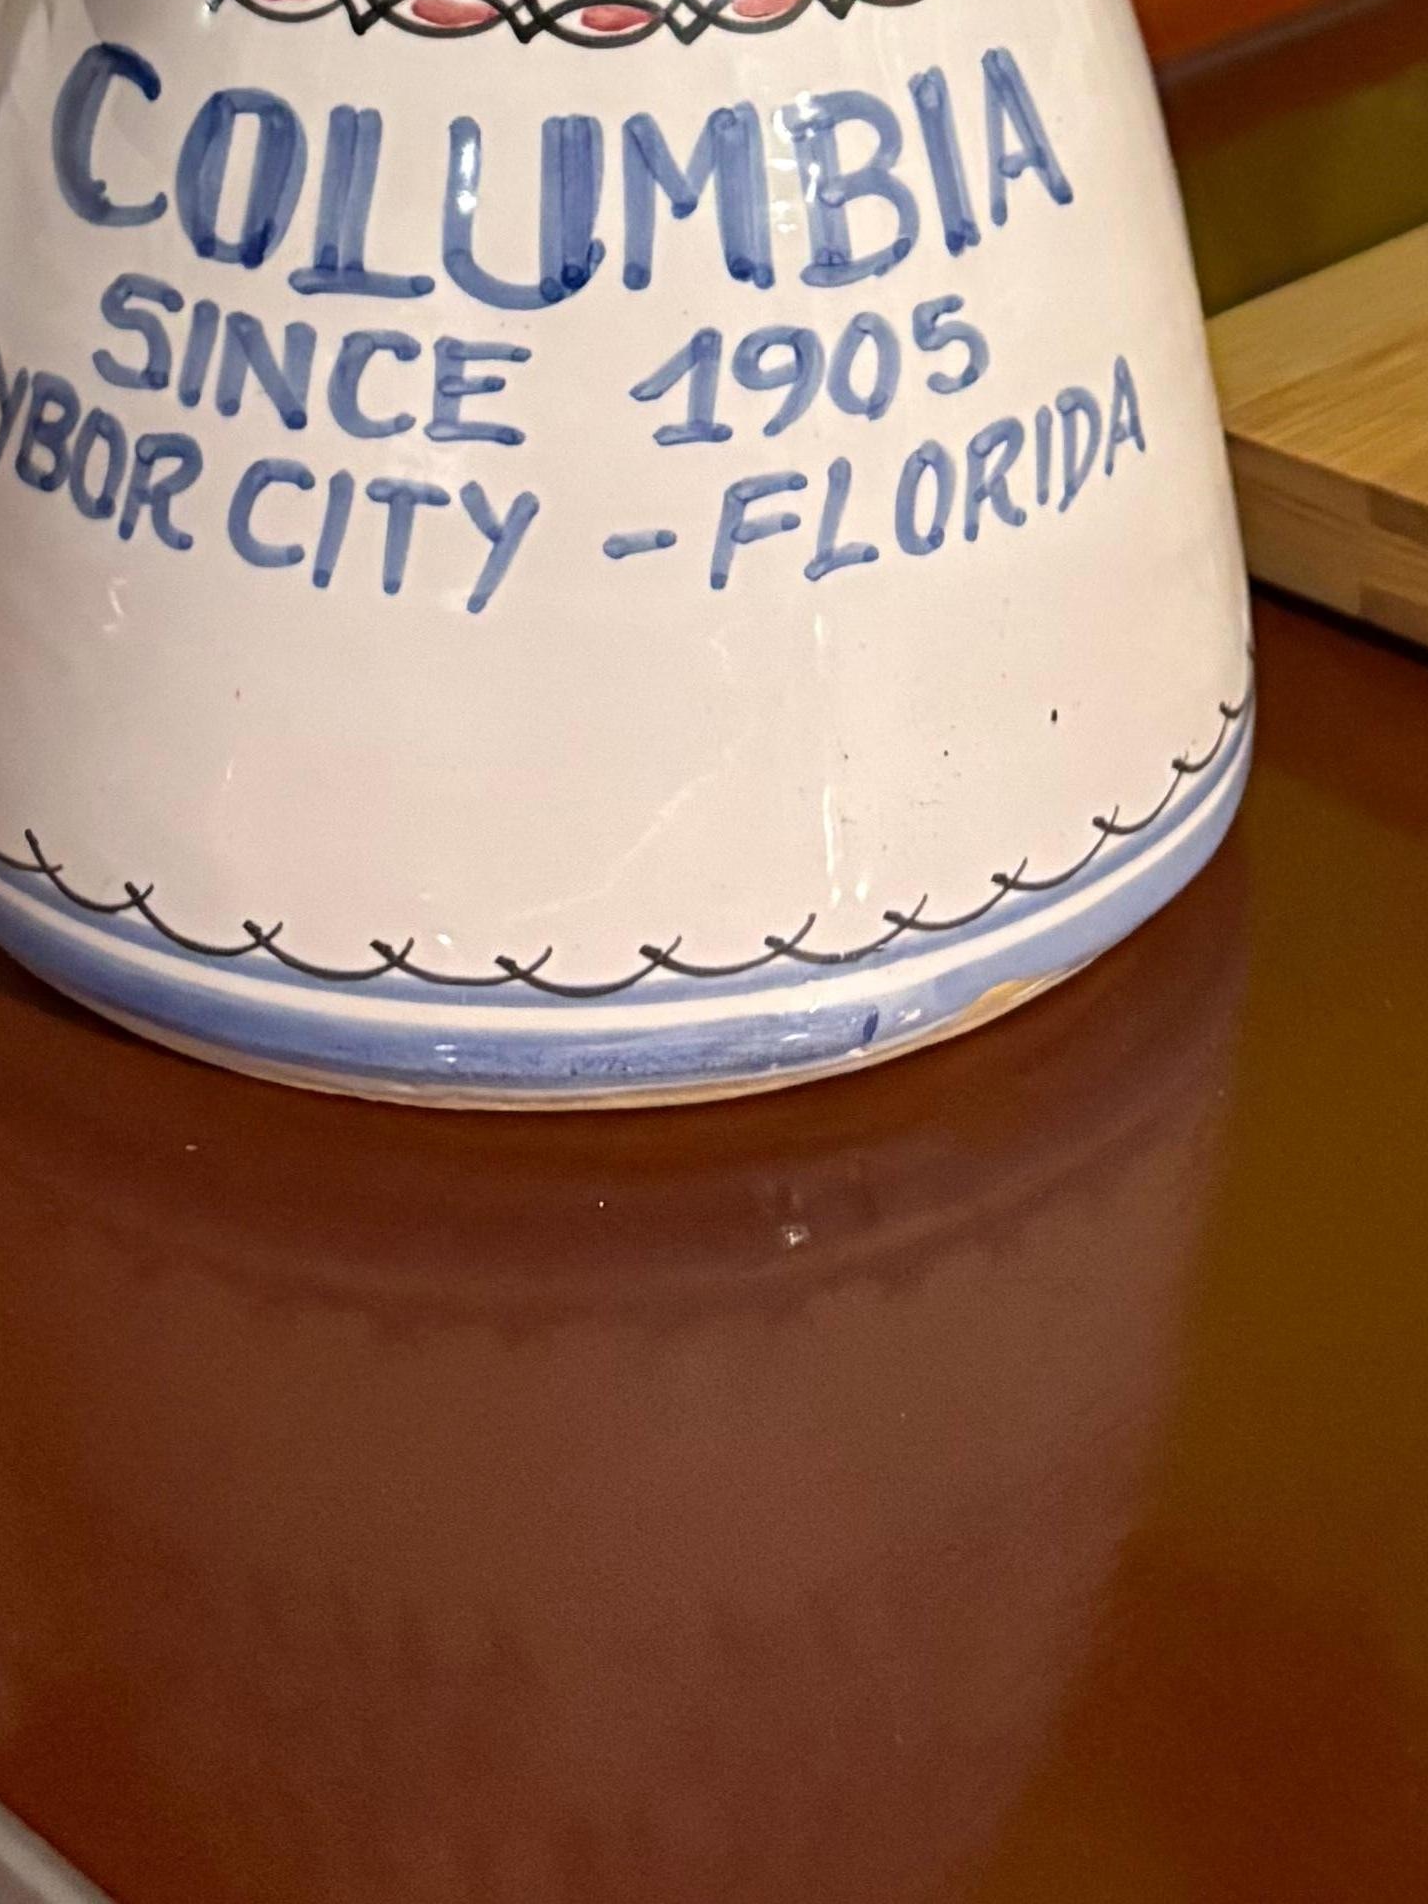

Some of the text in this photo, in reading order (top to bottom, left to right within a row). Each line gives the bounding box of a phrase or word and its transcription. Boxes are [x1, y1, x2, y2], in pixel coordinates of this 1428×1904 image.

[52, 42, 1074, 312] COLUMBIA
[92, 273, 990, 446] SINCE 1905
[227, 458, 540, 614] CITY
[708, 355, 1146, 591] FLORIDA
